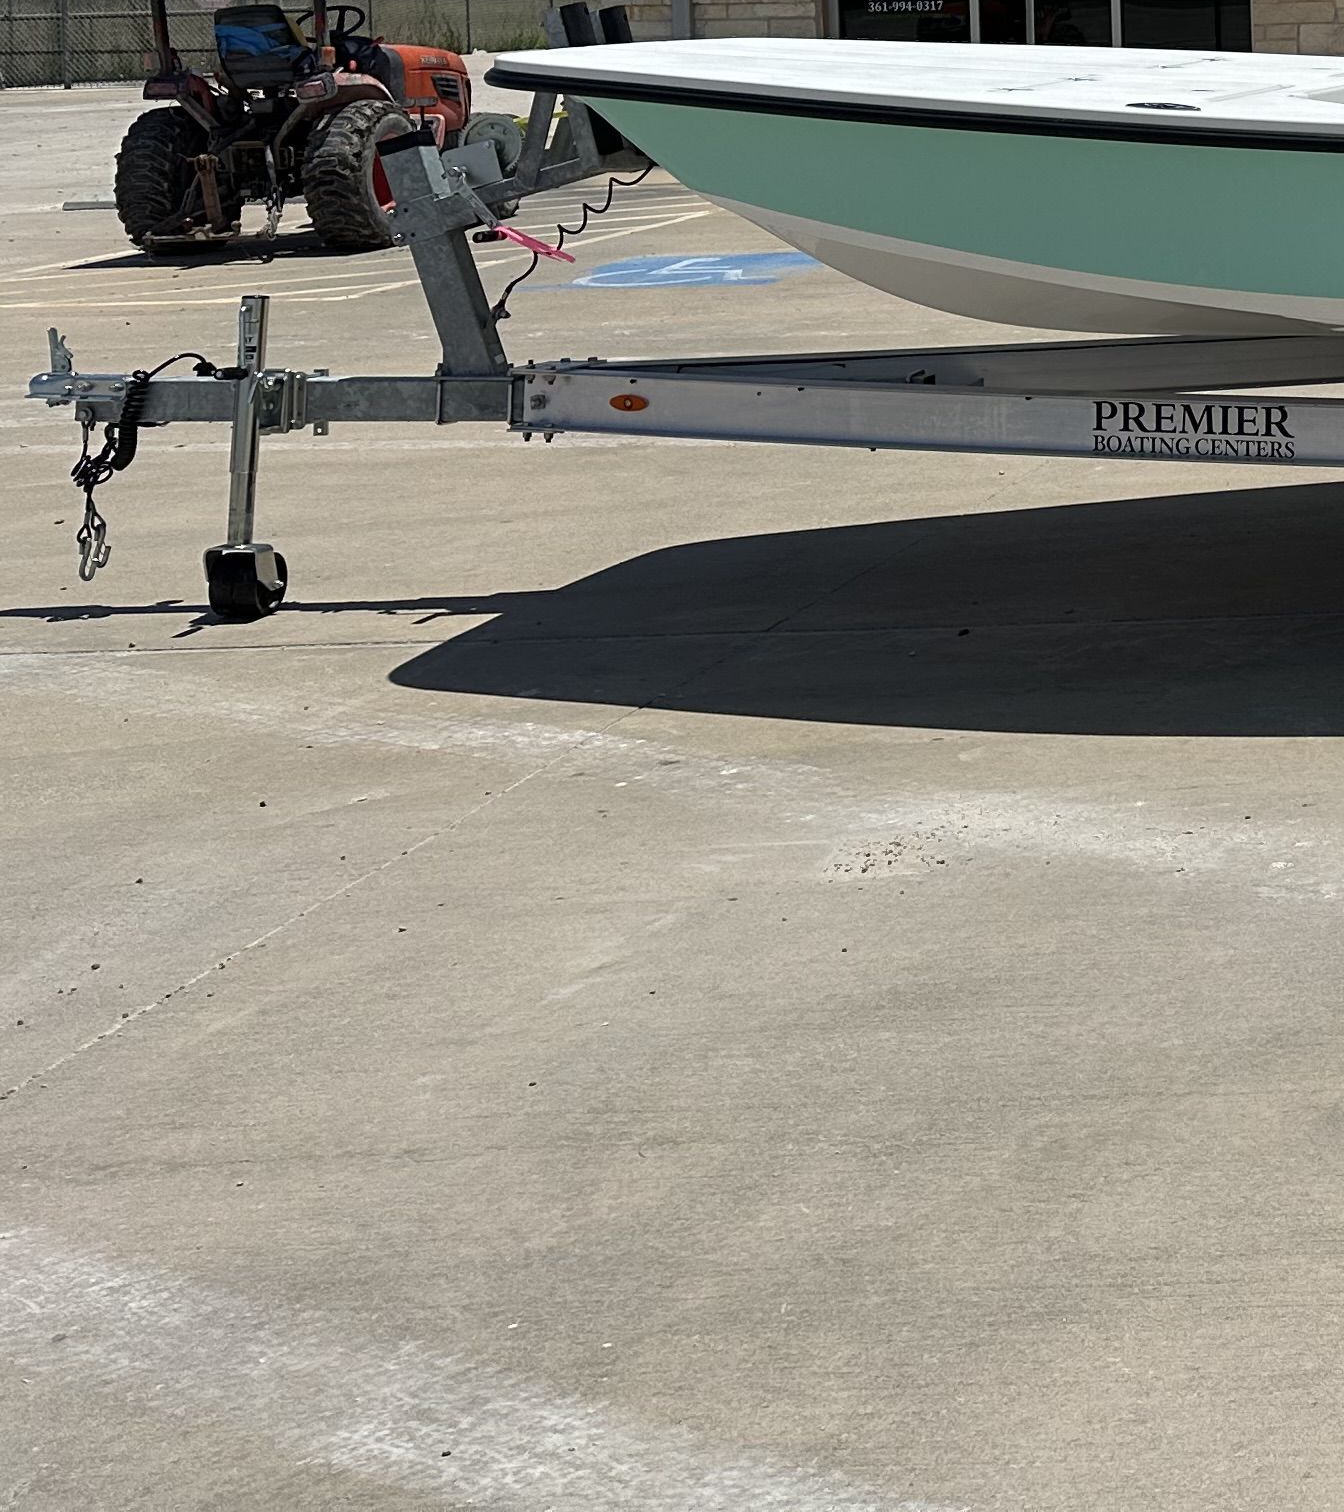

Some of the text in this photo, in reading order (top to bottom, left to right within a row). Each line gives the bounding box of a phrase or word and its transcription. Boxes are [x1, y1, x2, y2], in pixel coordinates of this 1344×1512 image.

[867, 1, 944, 13] 361-994-0317
[1092, 400, 1296, 439] PREMIER
[1092, 434, 1296, 459] BOATING CENTERS
